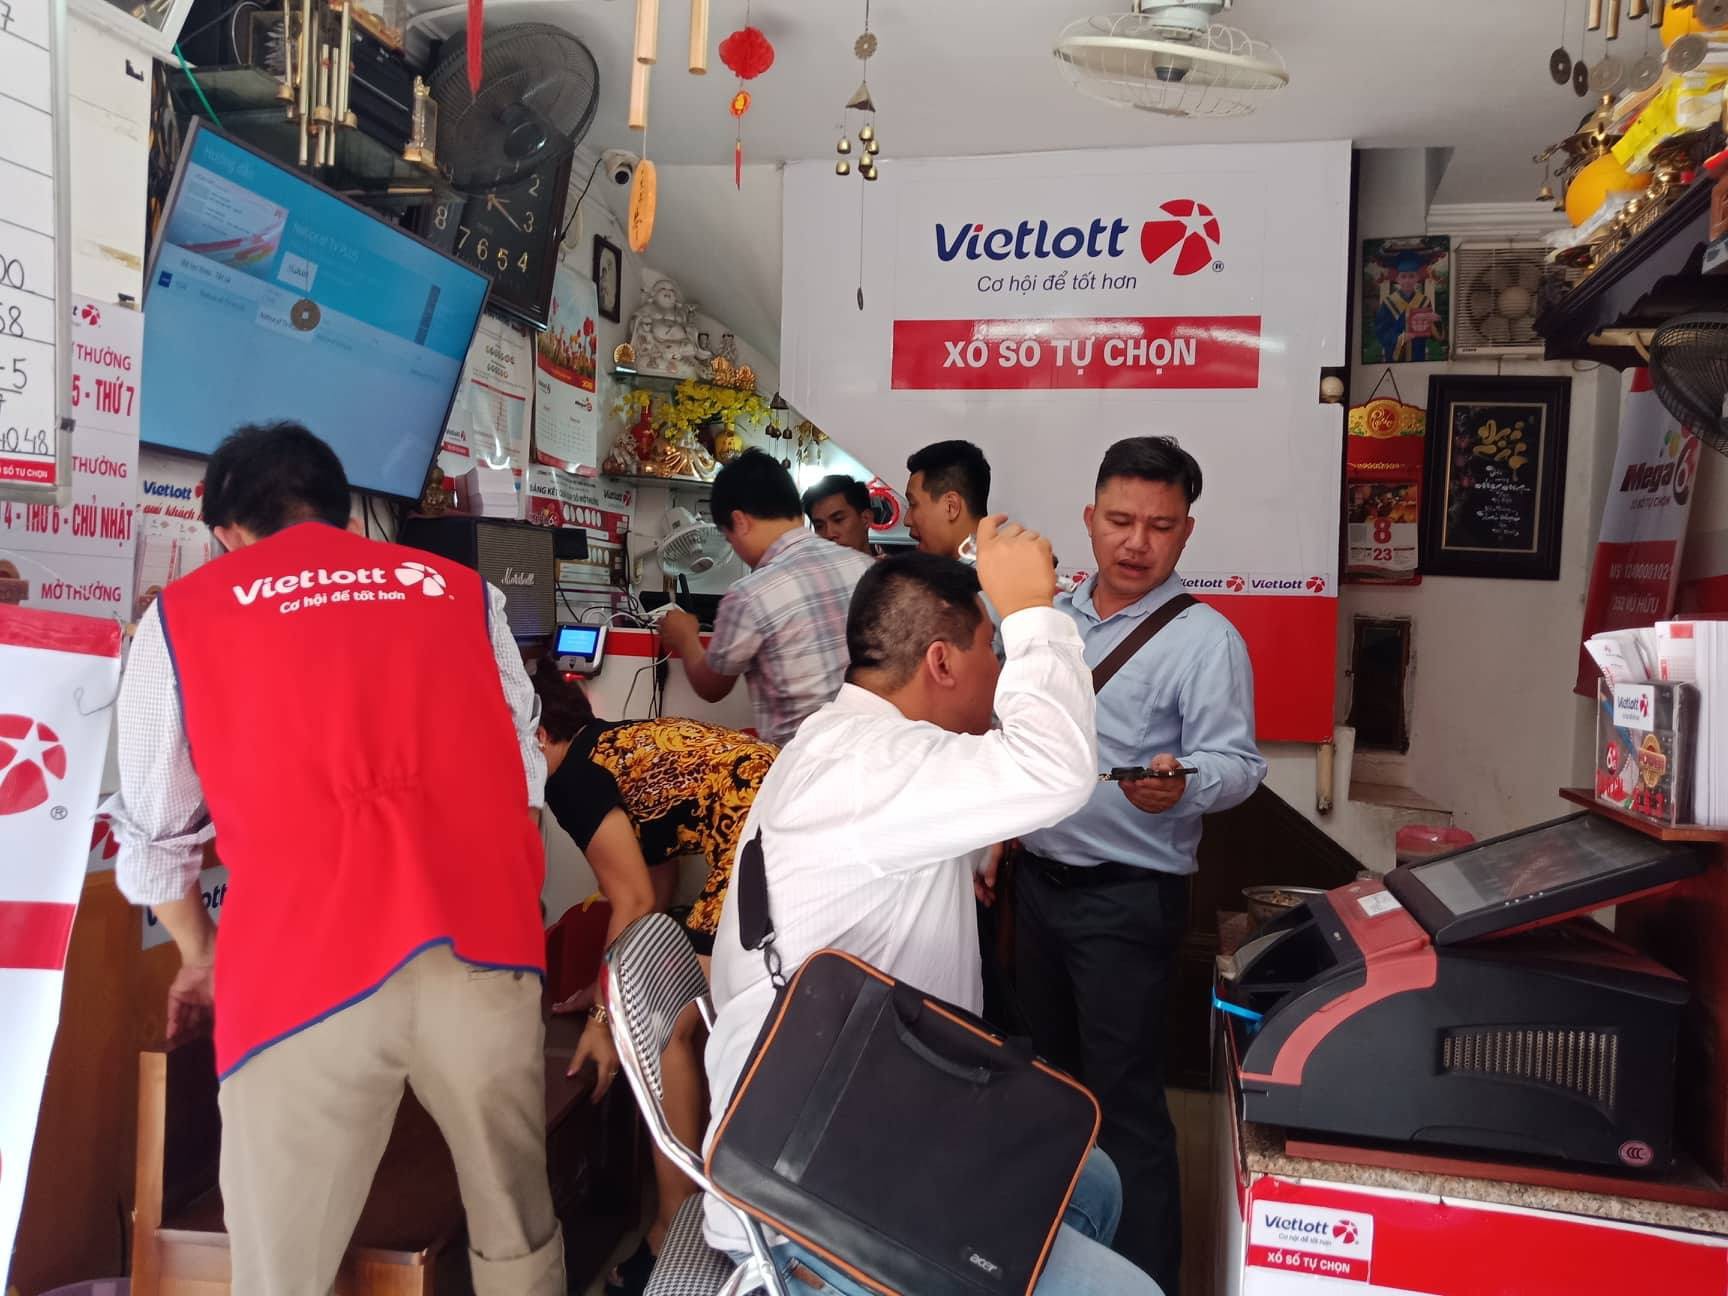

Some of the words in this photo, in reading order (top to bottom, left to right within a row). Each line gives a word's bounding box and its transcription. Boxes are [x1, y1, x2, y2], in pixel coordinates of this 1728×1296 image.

[477, 238, 489, 261] 6
[935, 217, 1129, 262] Vietlott
[497, 248, 509, 271] 5
[517, 251, 528, 273] 4
[977, 275, 1004, 293] Cơ
[1008, 274, 1037, 296] hội
[1042, 270, 1068, 291] để
[1072, 271, 1096, 290] tốt
[1101, 273, 1137, 290] hơn
[1050, 335, 1096, 376] TỰ
[1103, 337, 1197, 376] CHỌN
[126, 385, 136, 417] 7
[1619, 462, 1675, 494] Mega
[143, 480, 193, 501] Vietlott
[100, 501, 133, 547] NHẬT
[232, 567, 387, 606] Vietlott
[1251, 578, 1303, 590] Vietlott
[1264, 1214, 1328, 1235] Vietlott
[969, 1253, 998, 1272] acer
